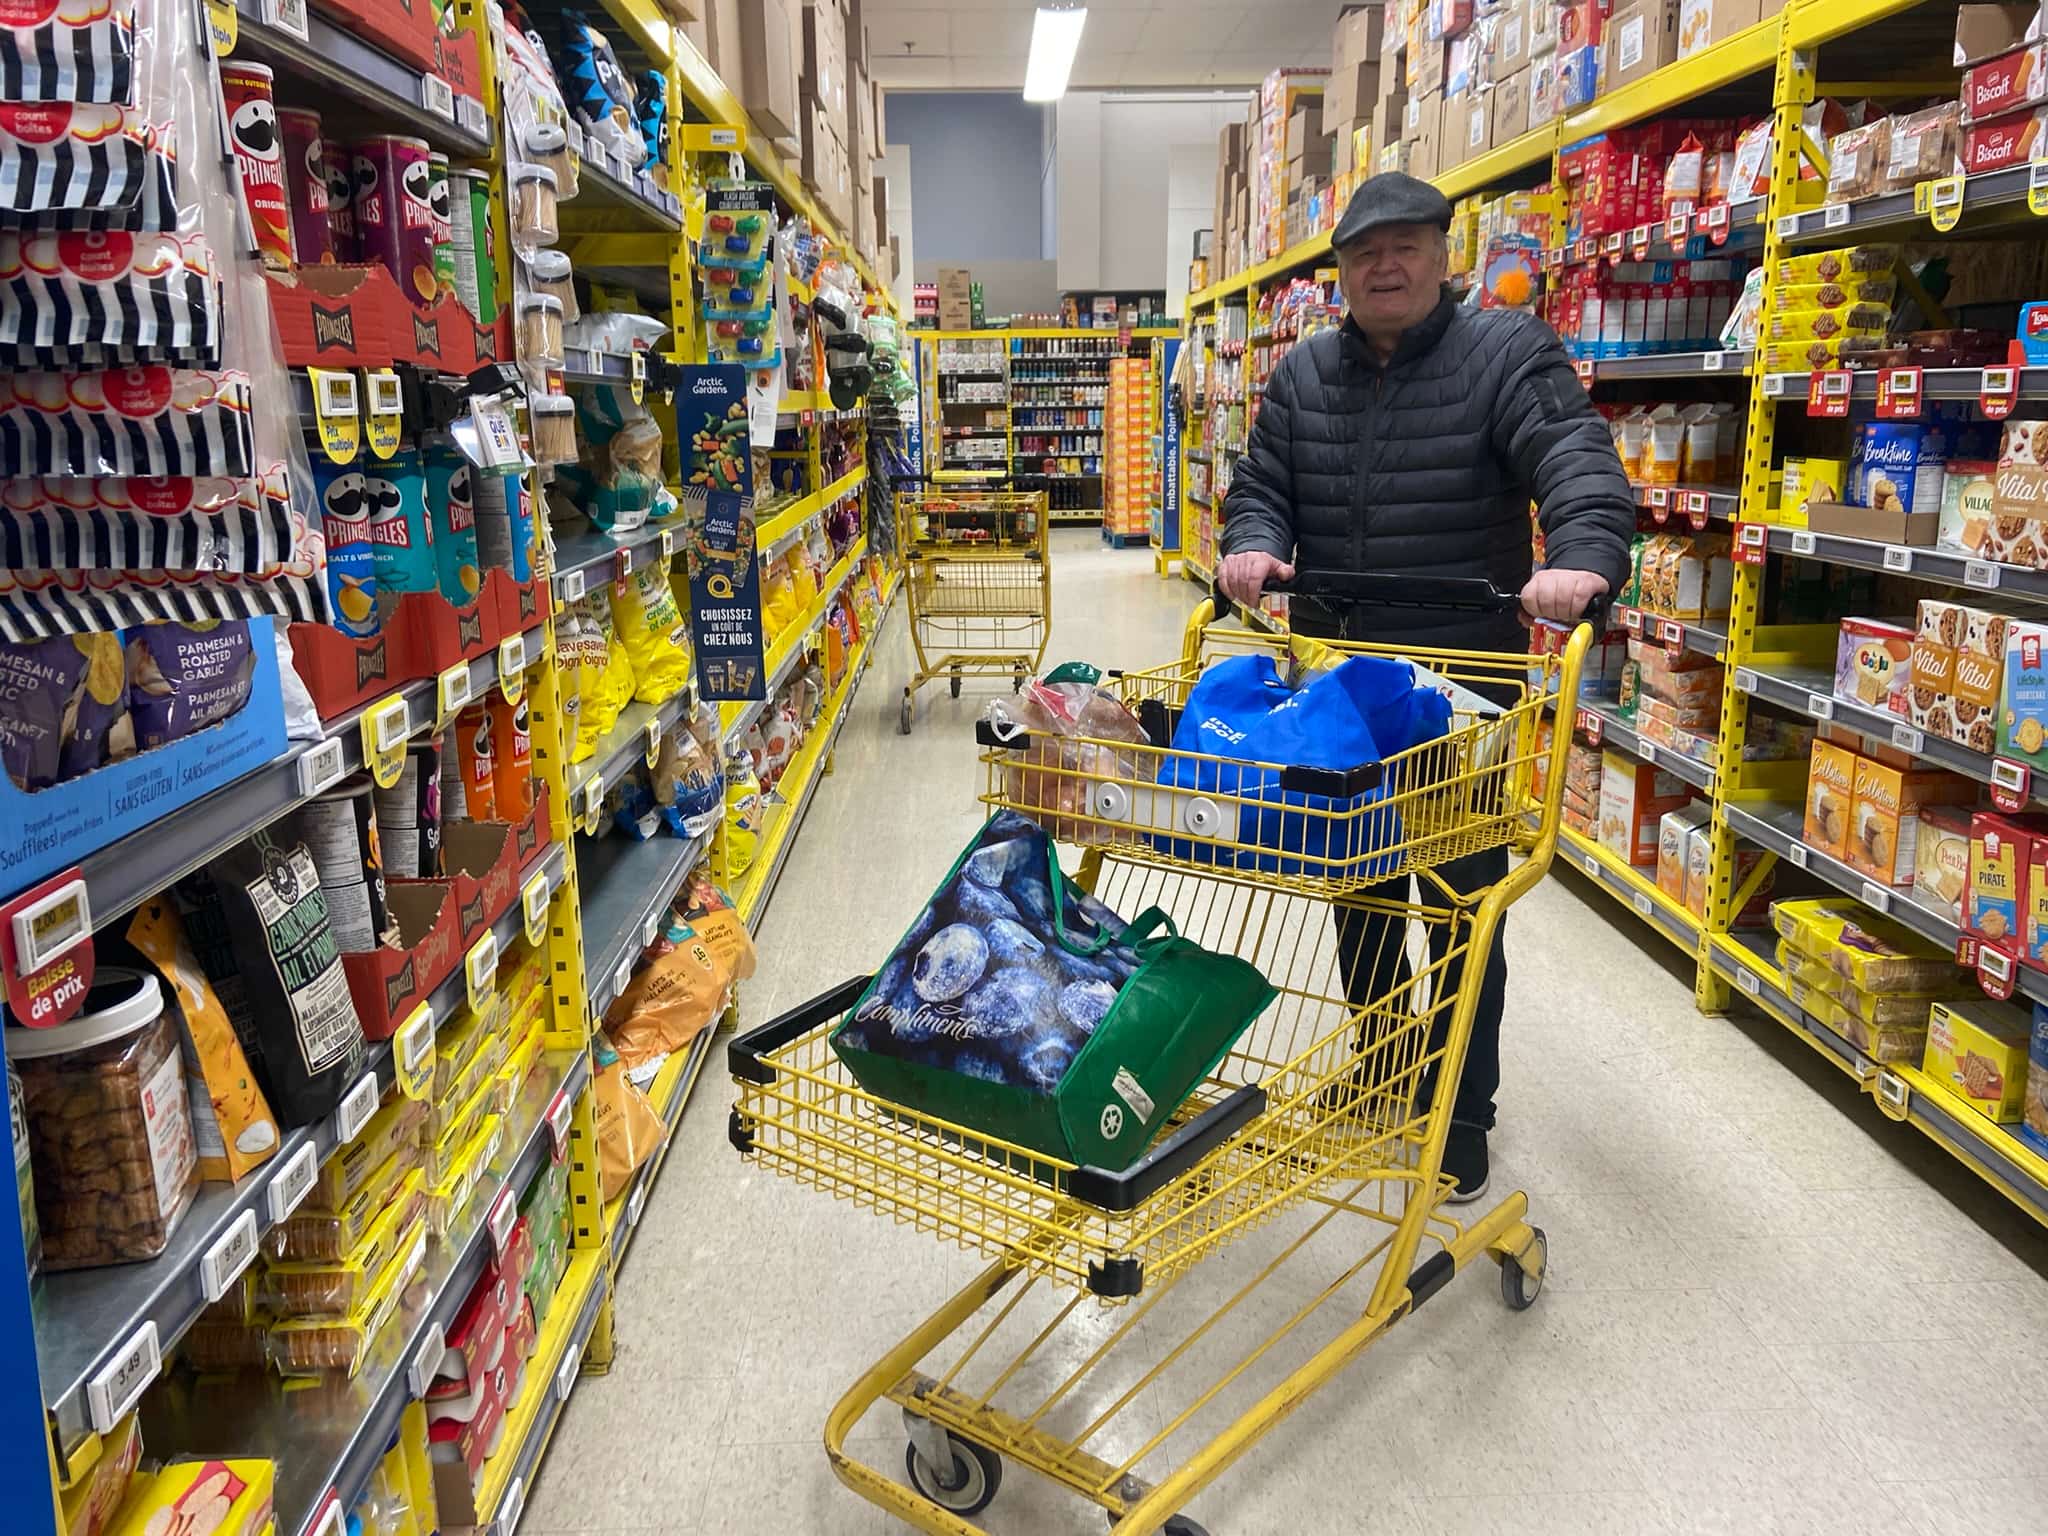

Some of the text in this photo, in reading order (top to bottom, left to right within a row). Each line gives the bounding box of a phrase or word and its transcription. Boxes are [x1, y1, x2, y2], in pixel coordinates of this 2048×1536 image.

[1976, 75, 2011, 104] Biscoff
[1976, 137, 2013, 163] Biscoff
[315, 311, 353, 346] PRINGLES
[692, 385, 728, 394] Gardens
[696, 377, 723, 386] Arctic
[1864, 440, 1912, 463] Breaktime
[1167, 446, 1177, 510] Imbattable.
[1998, 471, 2041, 501] Vital
[706, 524, 736, 536] Gardens
[711, 518, 733, 528] Arctic
[701, 608, 753, 621] CHOISISSEZ
[177, 633, 244, 656] PARMESAN &
[703, 633, 753, 645] CHEZ NOUS
[180, 649, 231, 669] ROASTED
[1914, 647, 1949, 678] Vital
[55, 672, 65, 685] &
[183, 663, 225, 681] GARLIC
[1957, 658, 1994, 690] Vital
[188, 683, 237, 706] PARMESAN
[190, 707, 206, 720] AIL
[181, 762, 203, 786] SANS
[114, 777, 173, 816] SANS GLUTEN
[1979, 871, 2007, 888] PIRATE
[27, 959, 75, 999] Baisse
[31, 975, 85, 1020] de prix
[855, 996, 978, 1041] Compliments
[118, 1351, 140, 1385] 3,49
